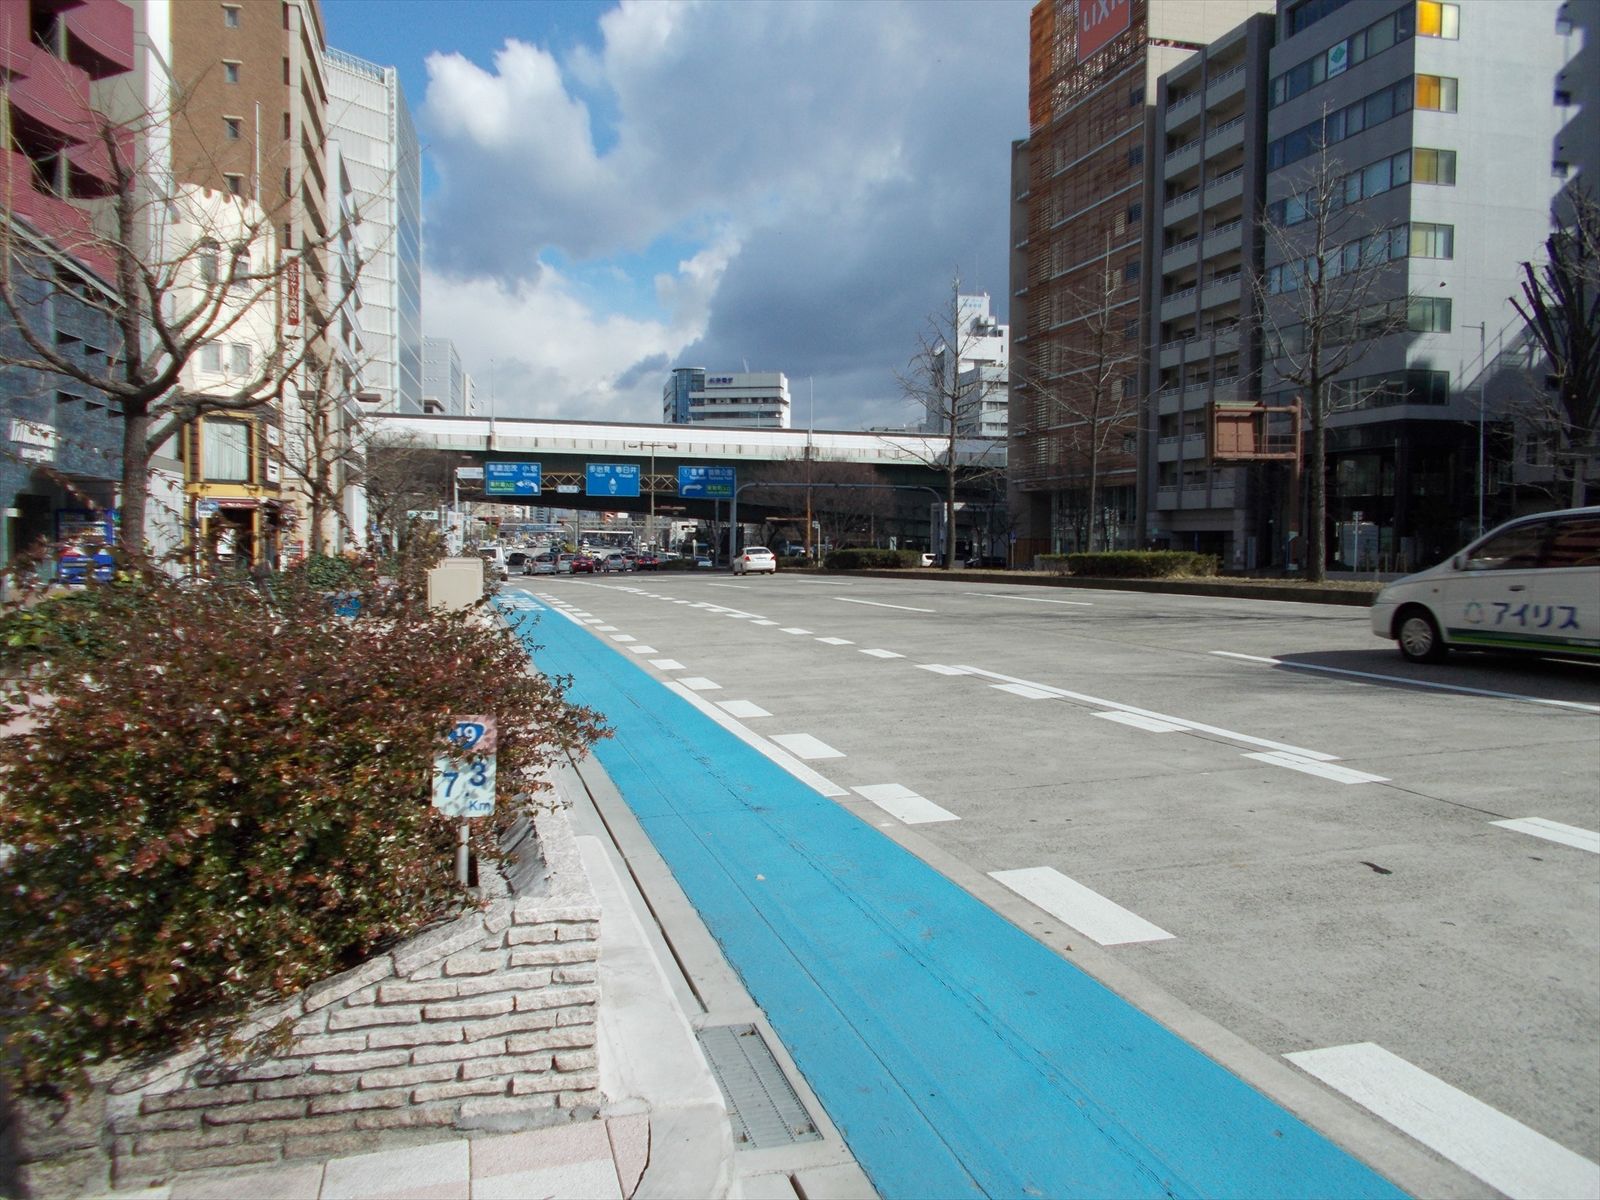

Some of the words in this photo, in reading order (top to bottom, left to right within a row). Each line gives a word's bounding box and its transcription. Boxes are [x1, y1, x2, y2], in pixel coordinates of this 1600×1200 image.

[1083, 0, 1124, 32] LIX
[1491, 602, 1580, 630] アイリス
[456, 726, 477, 742] 19
[468, 800, 491, 811] Km
